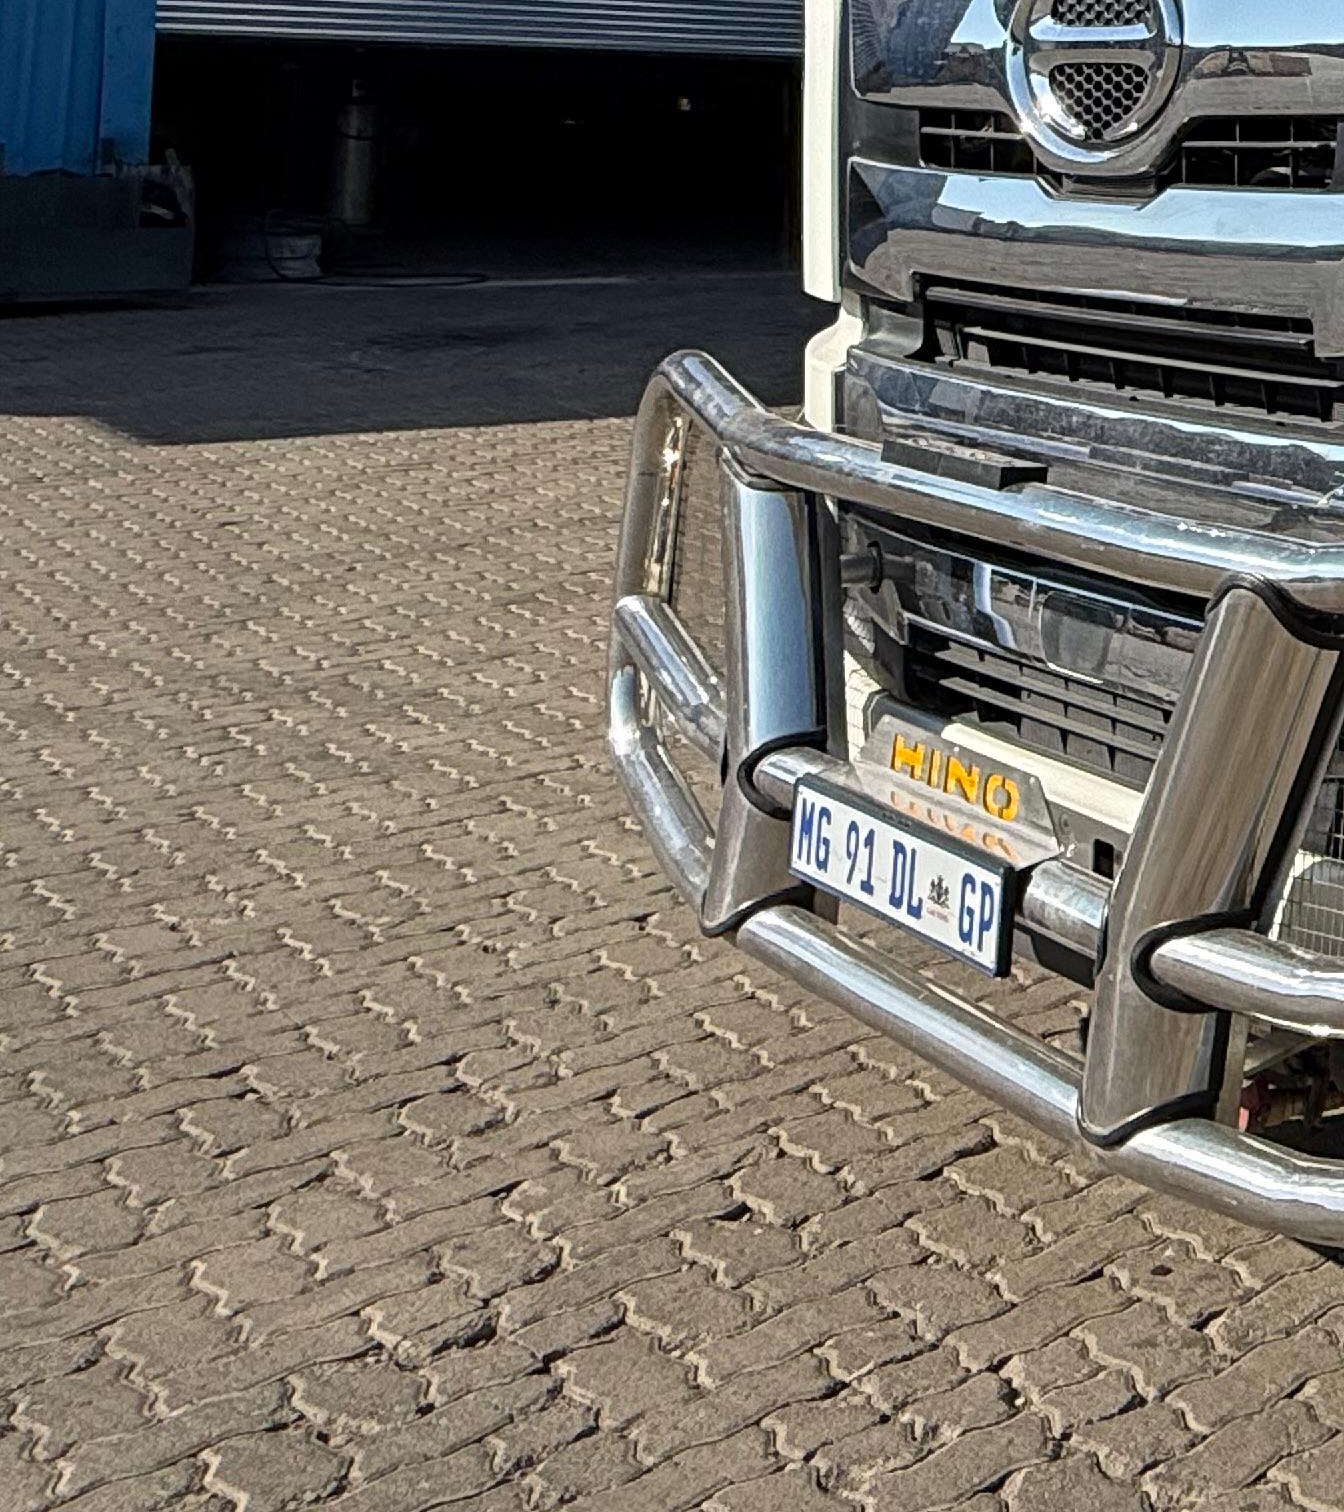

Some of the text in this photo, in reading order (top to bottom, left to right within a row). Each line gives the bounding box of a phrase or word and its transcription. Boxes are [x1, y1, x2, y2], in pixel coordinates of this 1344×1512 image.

[890, 733, 1021, 821] HINO
[797, 798, 995, 953] MG 91 DL GP
